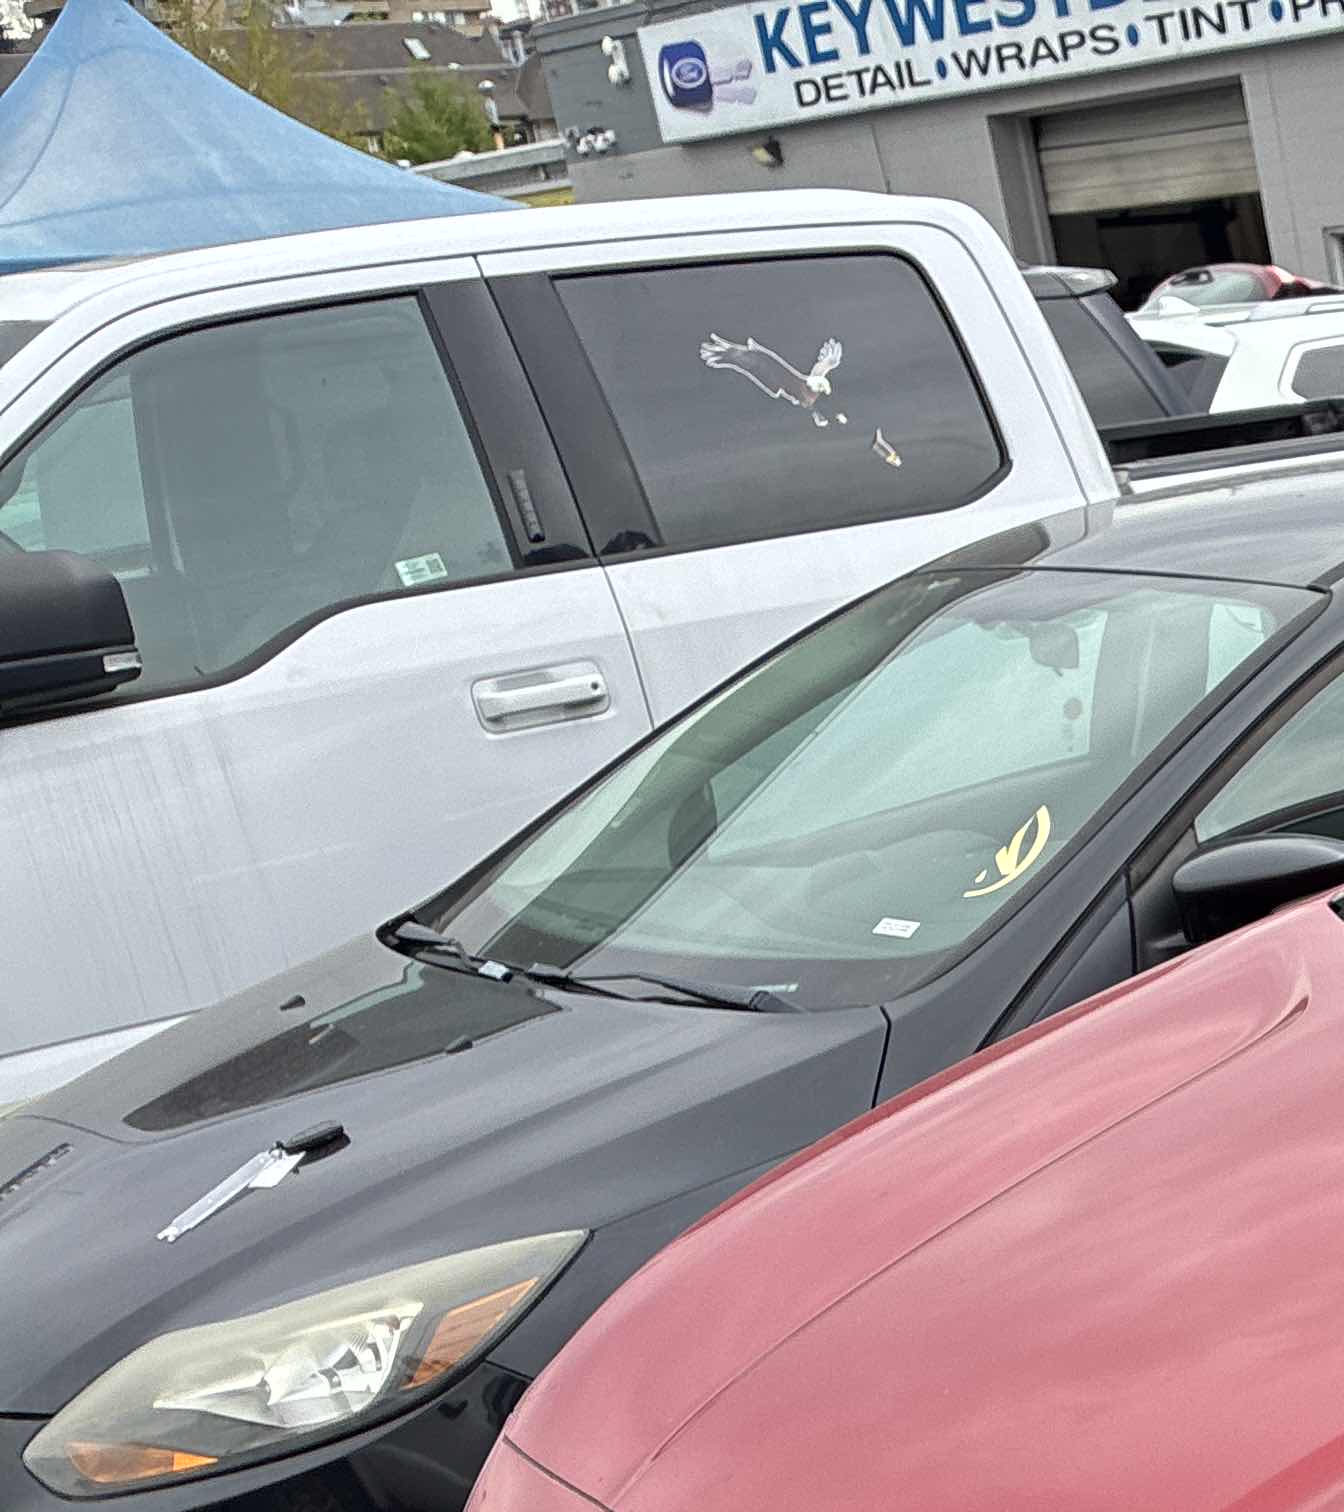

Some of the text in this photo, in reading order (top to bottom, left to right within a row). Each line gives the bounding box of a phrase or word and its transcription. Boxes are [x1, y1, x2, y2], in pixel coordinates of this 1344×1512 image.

[753, 0, 1070, 74] KEYWE
[793, 59, 931, 108] DETAIL
[951, 24, 1121, 79] WRAPS
[1143, 0, 1258, 46] TINT
